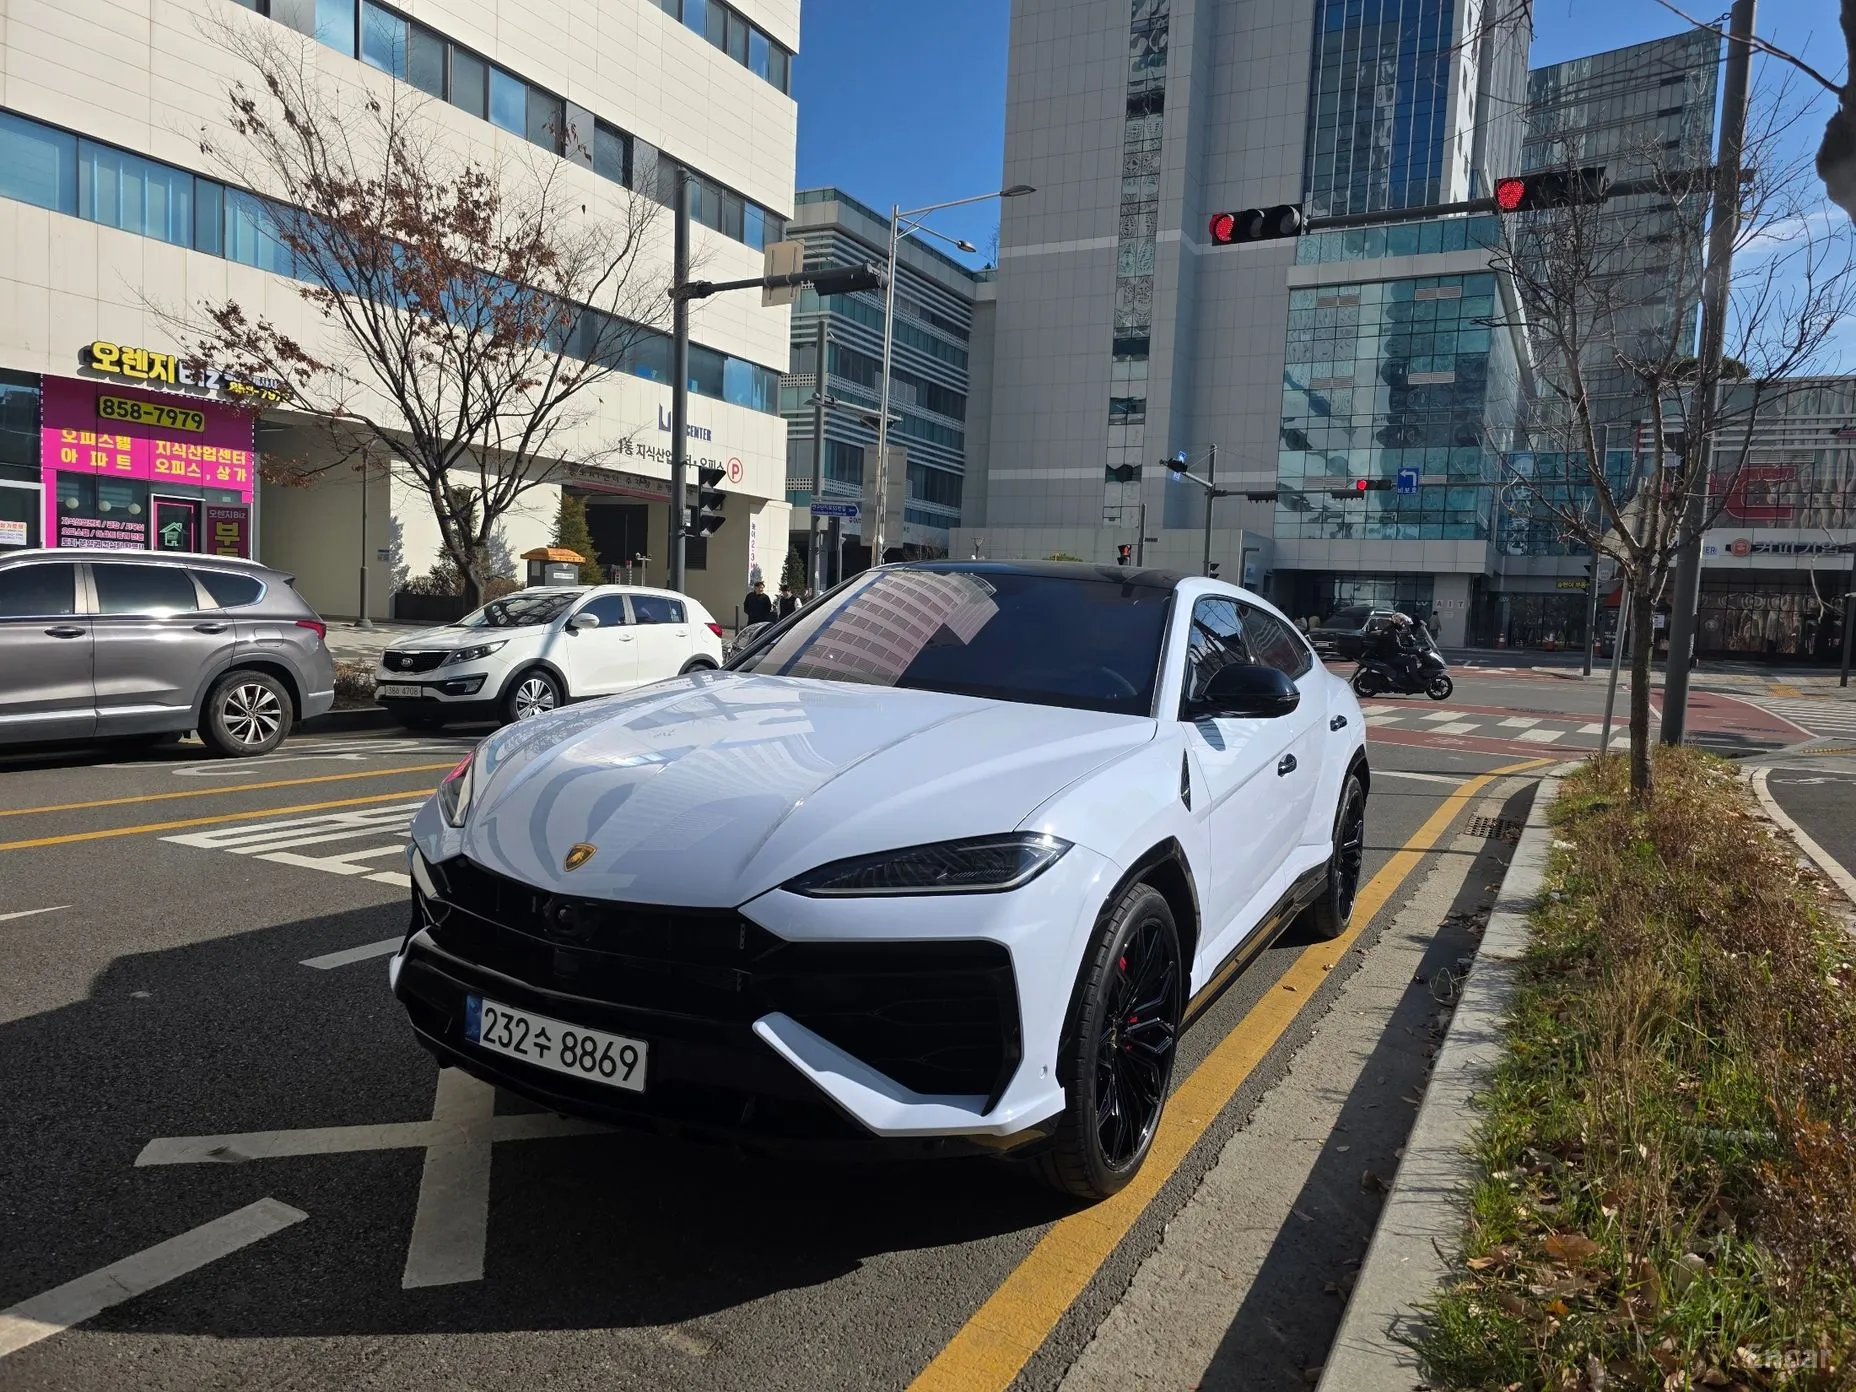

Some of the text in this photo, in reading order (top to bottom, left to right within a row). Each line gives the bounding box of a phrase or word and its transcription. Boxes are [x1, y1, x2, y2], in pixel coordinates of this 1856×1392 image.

[102, 398, 203, 430] 858-7979
[61, 429, 132, 451] 오피스텔
[155, 440, 246, 465] 지식산업센터
[636, 443, 692, 468] 지식산업터
[216, 466, 247, 482] 상가
[482, 1007, 639, 1082] 232수 8869
